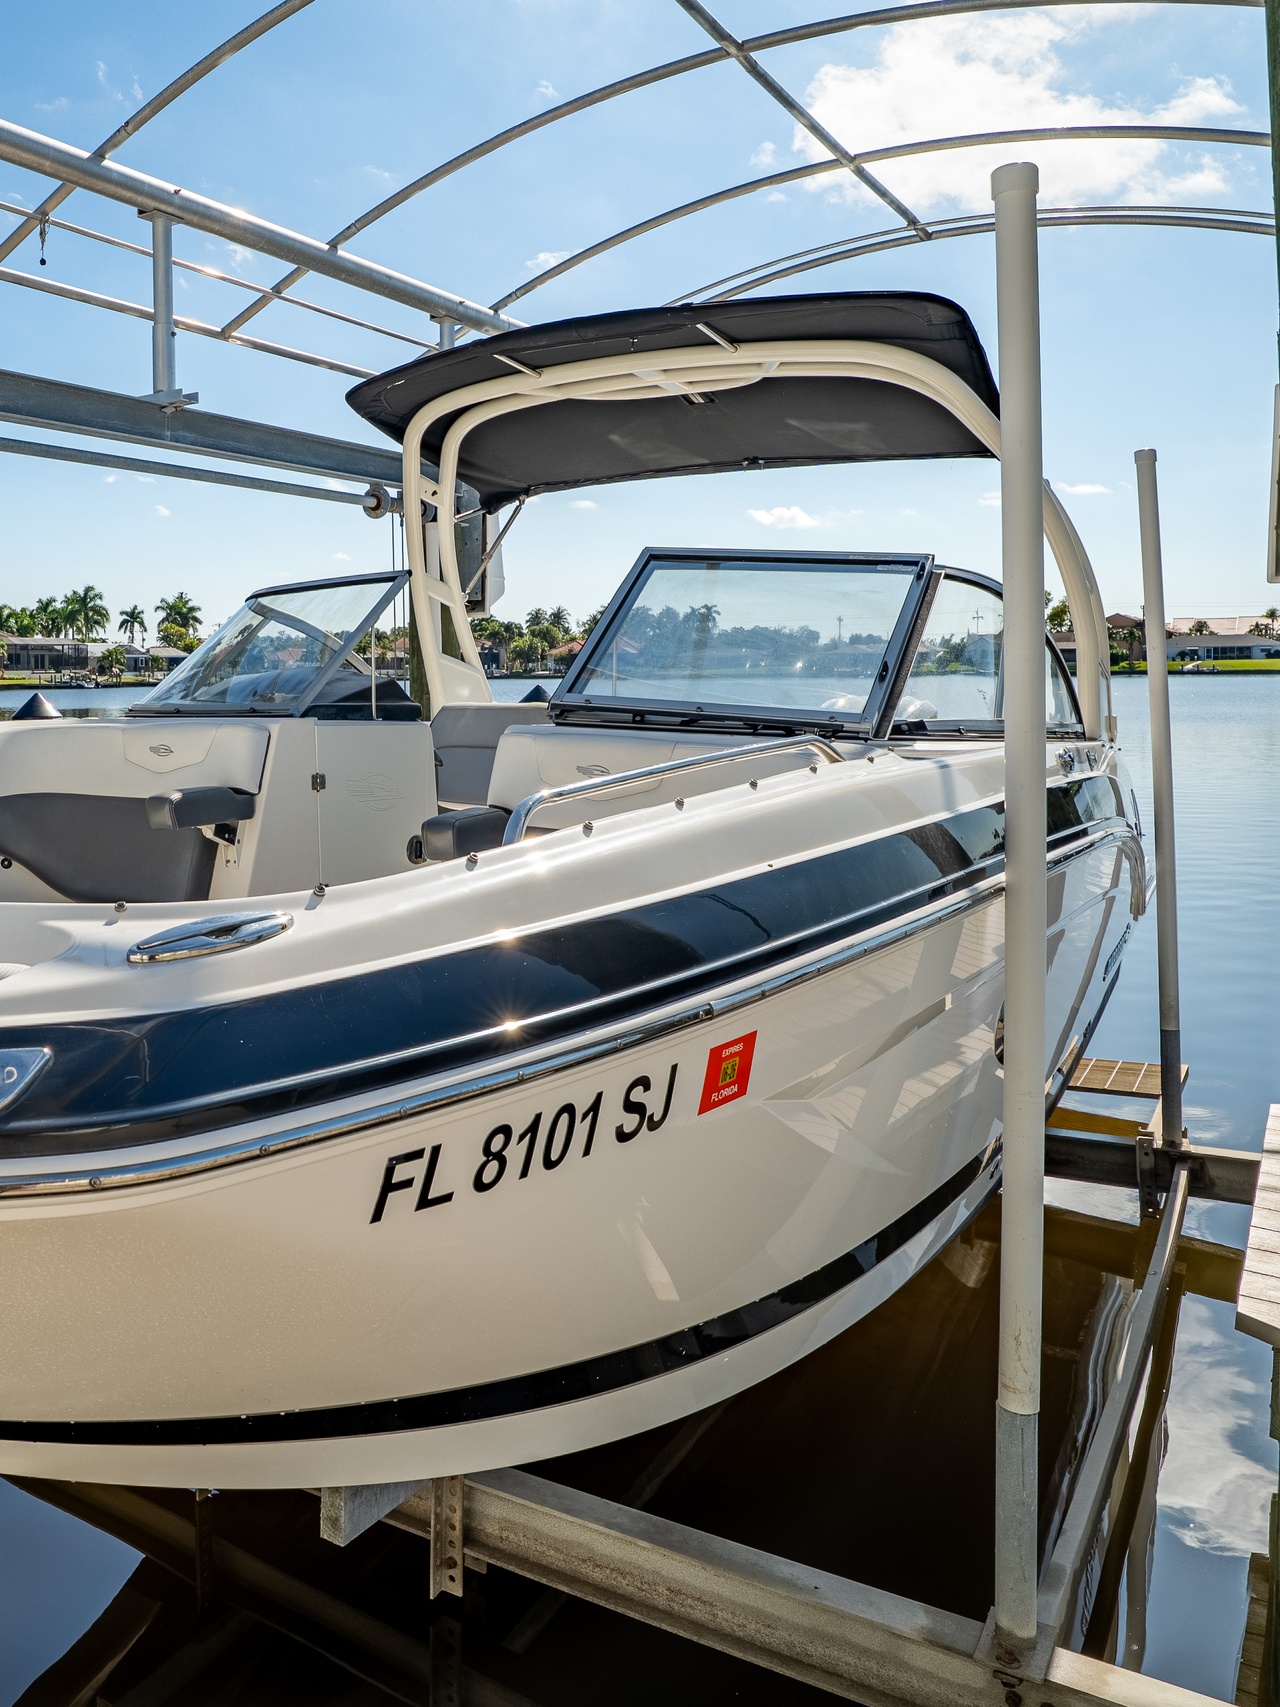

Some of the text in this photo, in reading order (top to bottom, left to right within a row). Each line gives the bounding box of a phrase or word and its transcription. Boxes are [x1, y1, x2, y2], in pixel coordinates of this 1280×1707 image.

[722, 1042, 744, 1057] EXPIRES
[711, 1084, 738, 1103] FLORIDA
[369, 1062, 679, 1225] FL 8101 SJ
